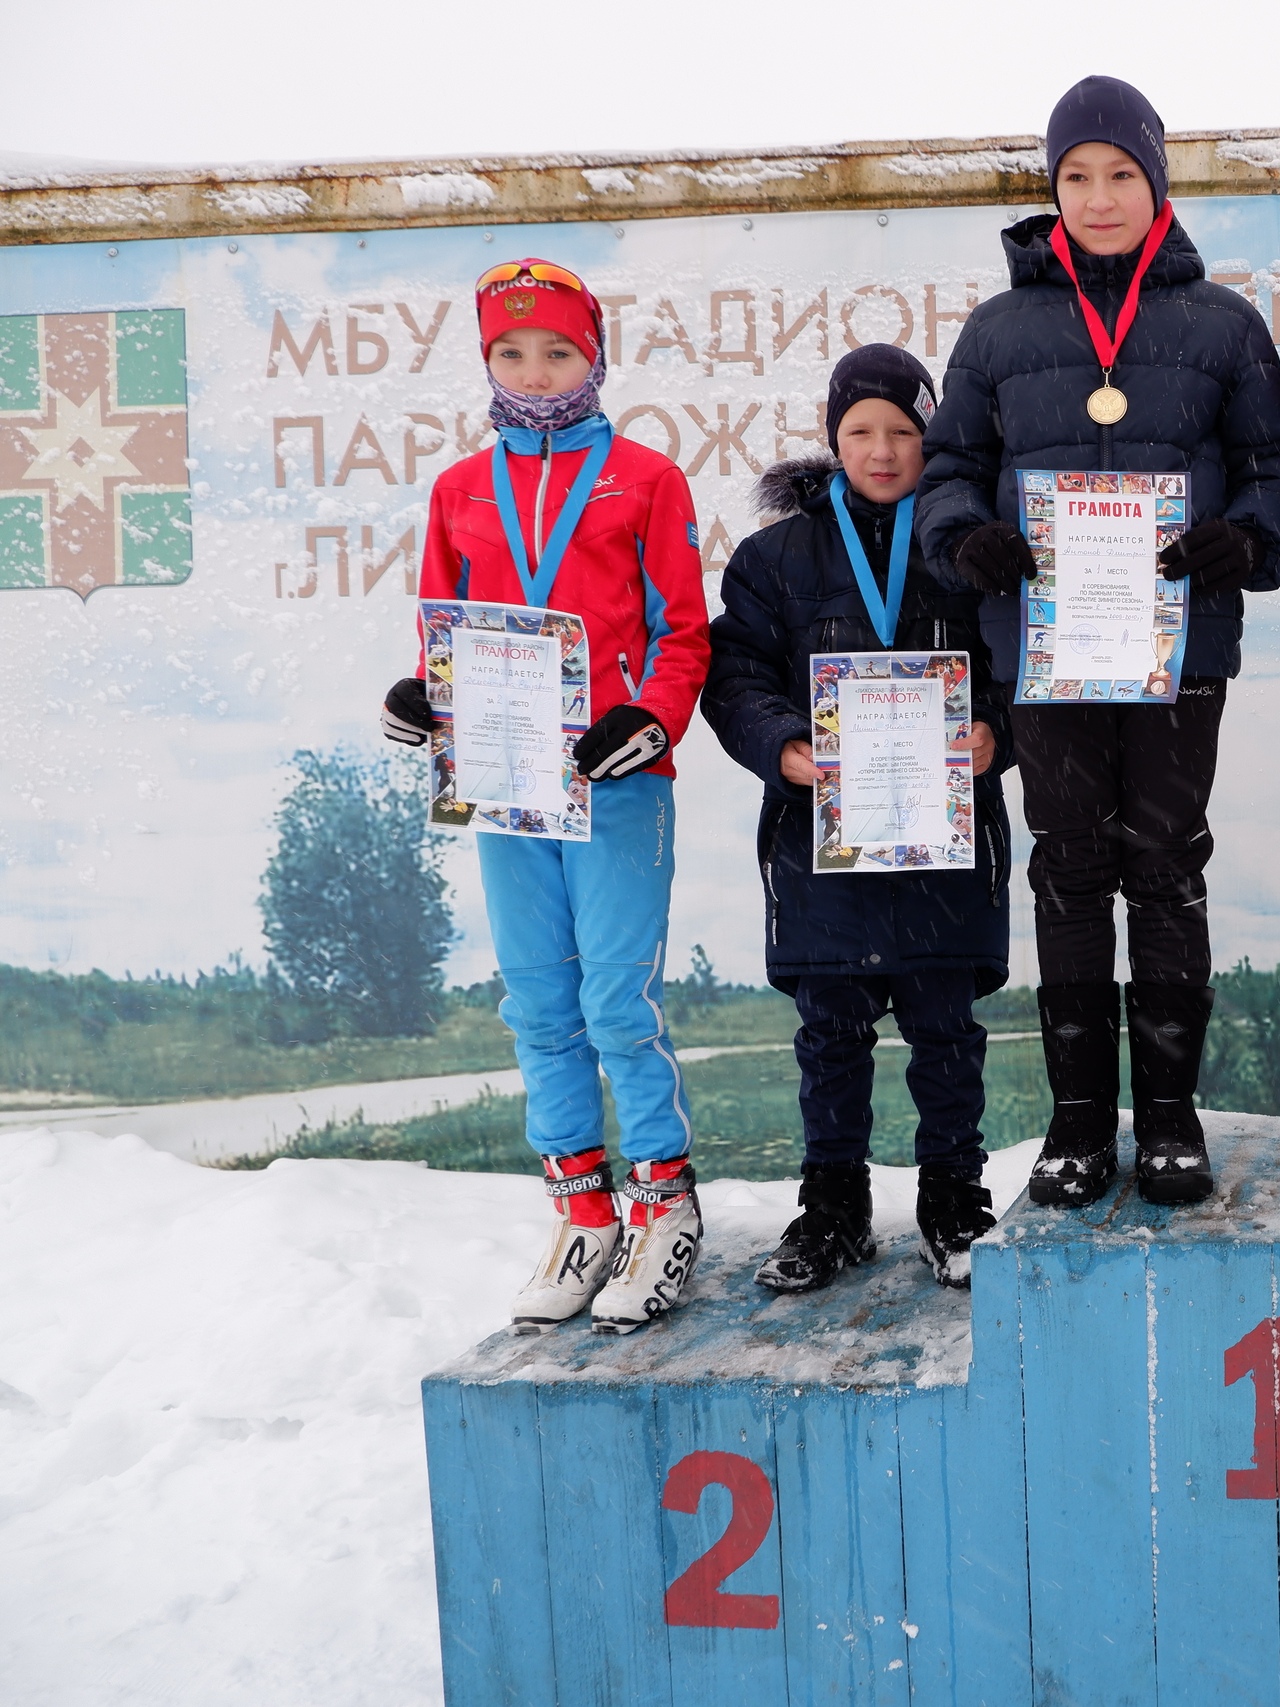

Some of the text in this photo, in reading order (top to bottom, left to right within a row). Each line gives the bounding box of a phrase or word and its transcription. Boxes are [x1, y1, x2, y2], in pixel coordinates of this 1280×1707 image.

[266, 283, 980, 378] МБУ ТАДИОН
[272, 410, 492, 488] ПАРК
[1068, 501, 1142, 518] ГРАМОТА
[1068, 536, 1144, 544] НАГРАЖДАЕТСЯ
[475, 645, 537, 661] ГРАМОТА
[472, 666, 544, 678] НАГРАДАЕТСЯ
[861, 693, 922, 704] ГРАМОТА
[547, 1175, 602, 1196] OSSIGNO
[557, 1236, 600, 1285] R
[661, 1449, 780, 1629] 2
